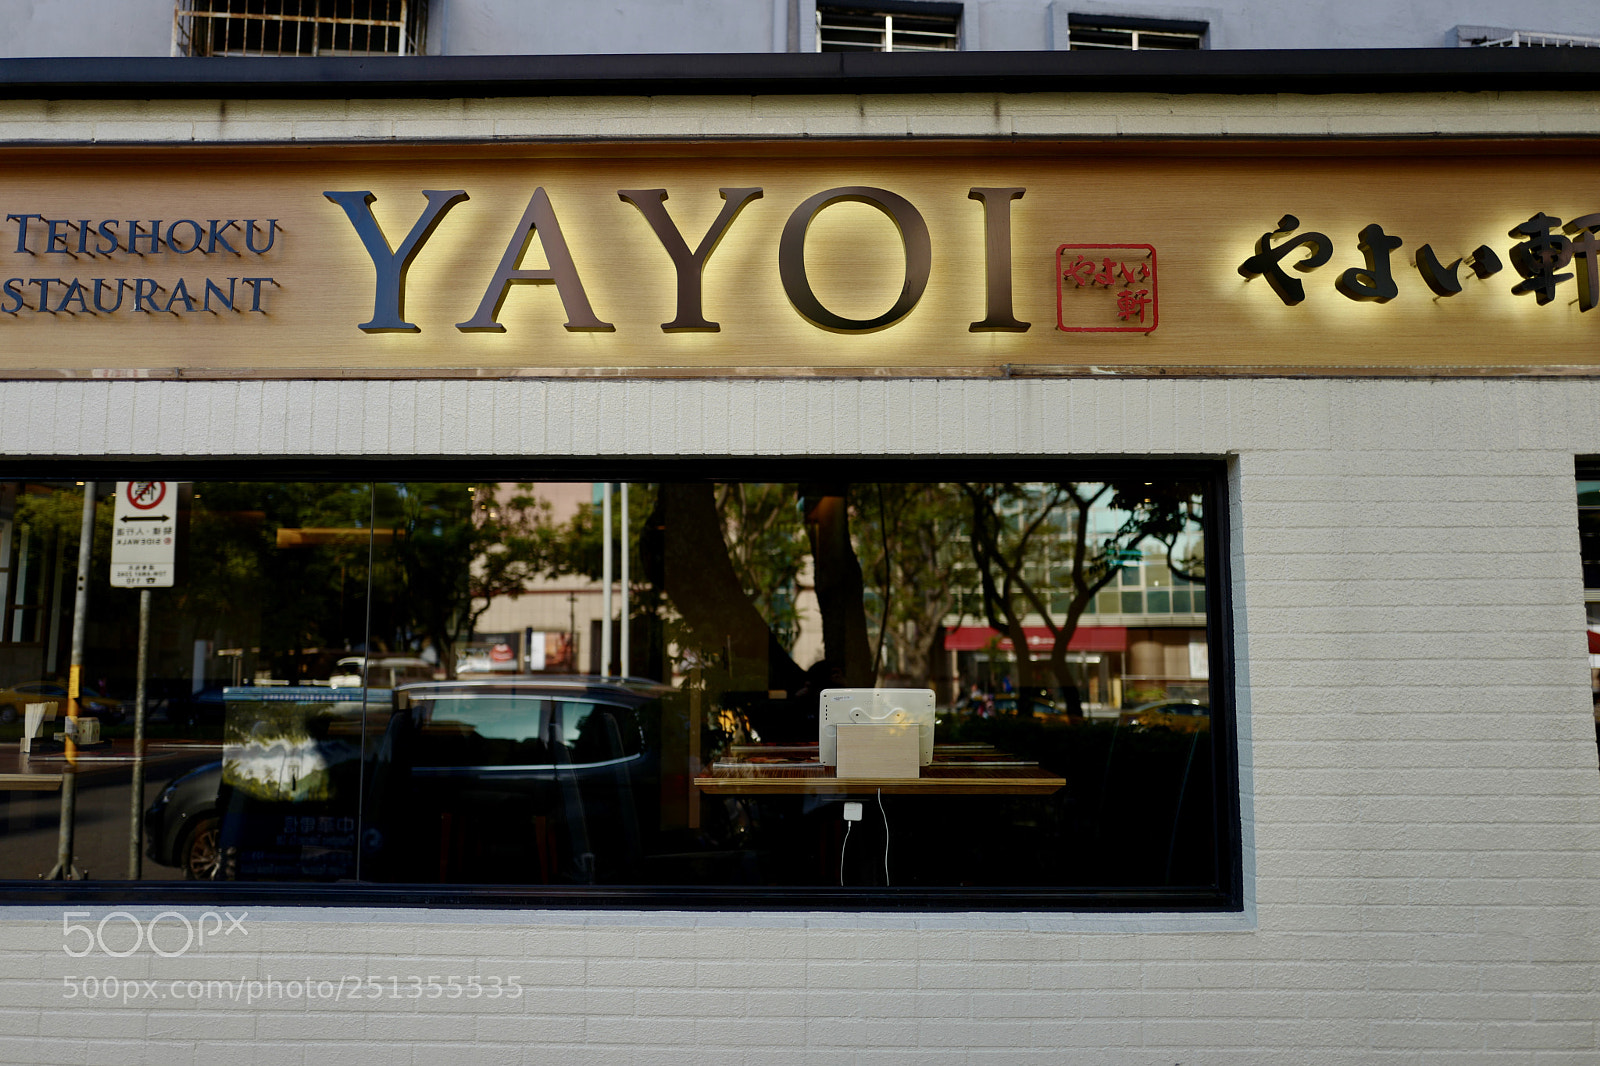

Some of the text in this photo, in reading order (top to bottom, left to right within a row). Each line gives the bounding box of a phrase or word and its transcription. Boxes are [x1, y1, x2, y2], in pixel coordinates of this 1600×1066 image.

[6, 213, 280, 255] TEISHOKU
[323, 186, 1032, 334] YAYOI
[1063, 254, 1151, 286] やよい
[1237, 211, 1600, 313] やよい軒
[0, 277, 274, 313] STAURANT
[1117, 289, 1152, 324] 軒
